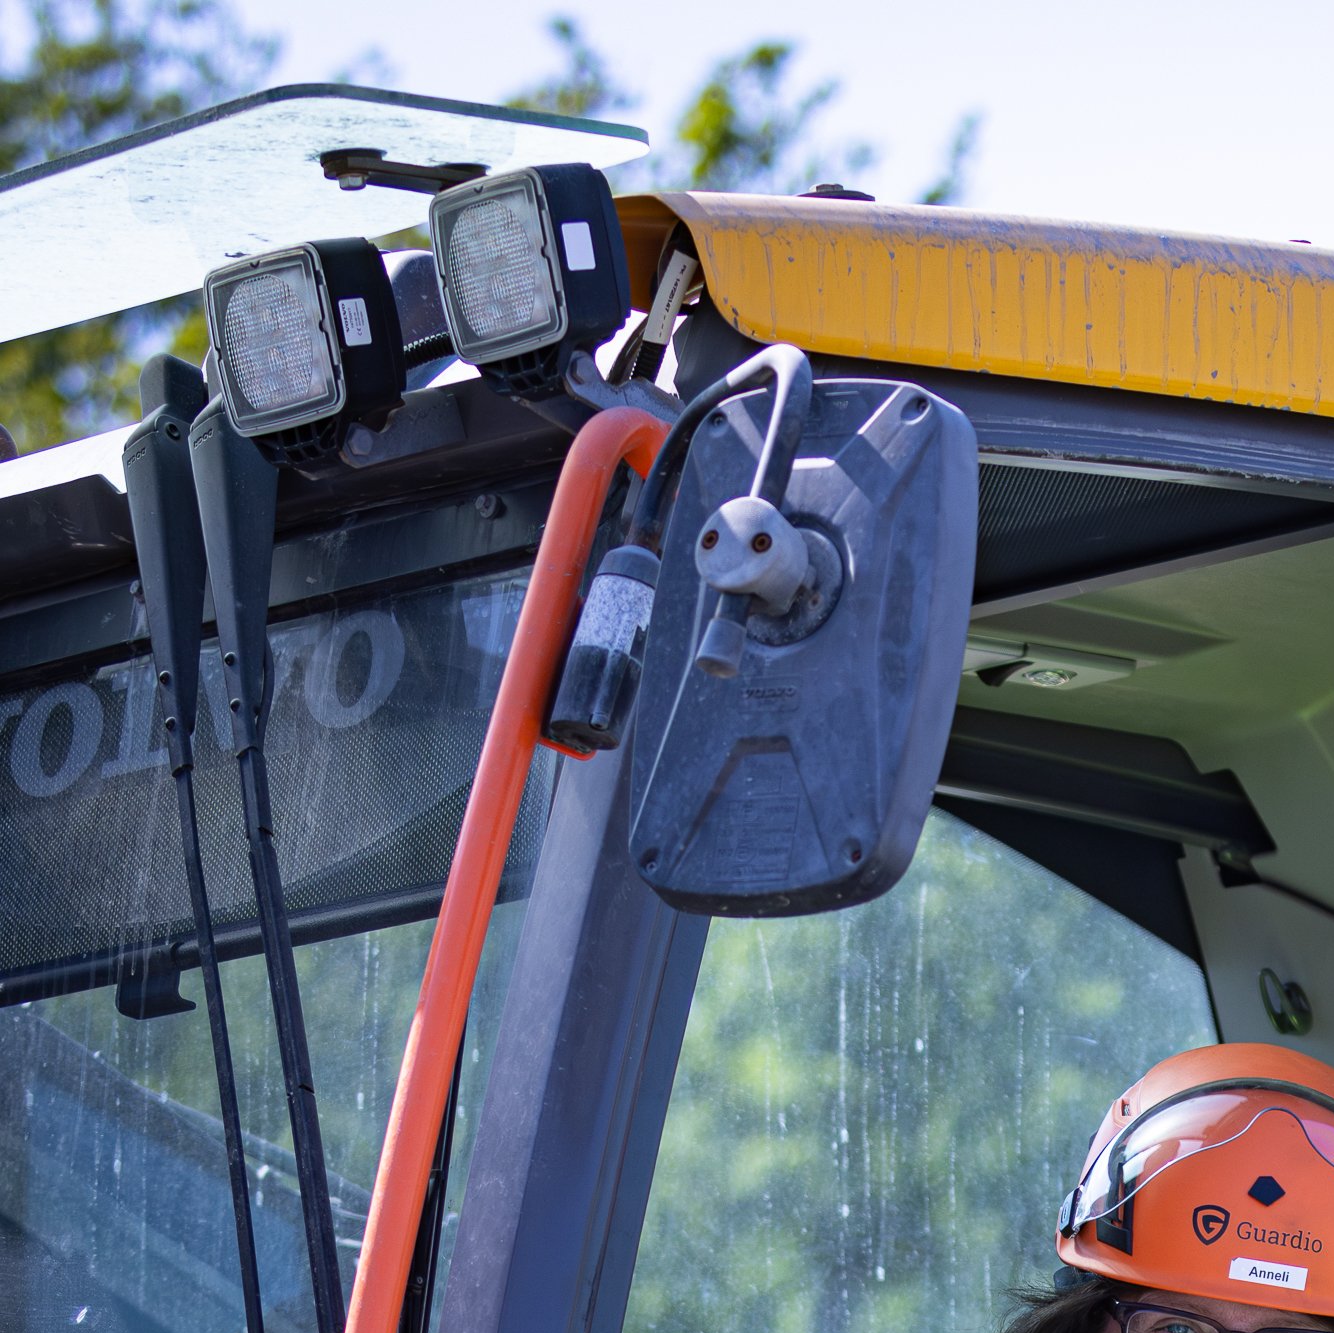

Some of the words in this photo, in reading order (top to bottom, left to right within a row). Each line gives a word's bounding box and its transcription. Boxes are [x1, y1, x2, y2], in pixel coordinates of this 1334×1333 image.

[0, 608, 406, 798] OLVO
[1236, 1221, 1323, 1253] Guardio
[1248, 1266, 1290, 1282] Anneli
